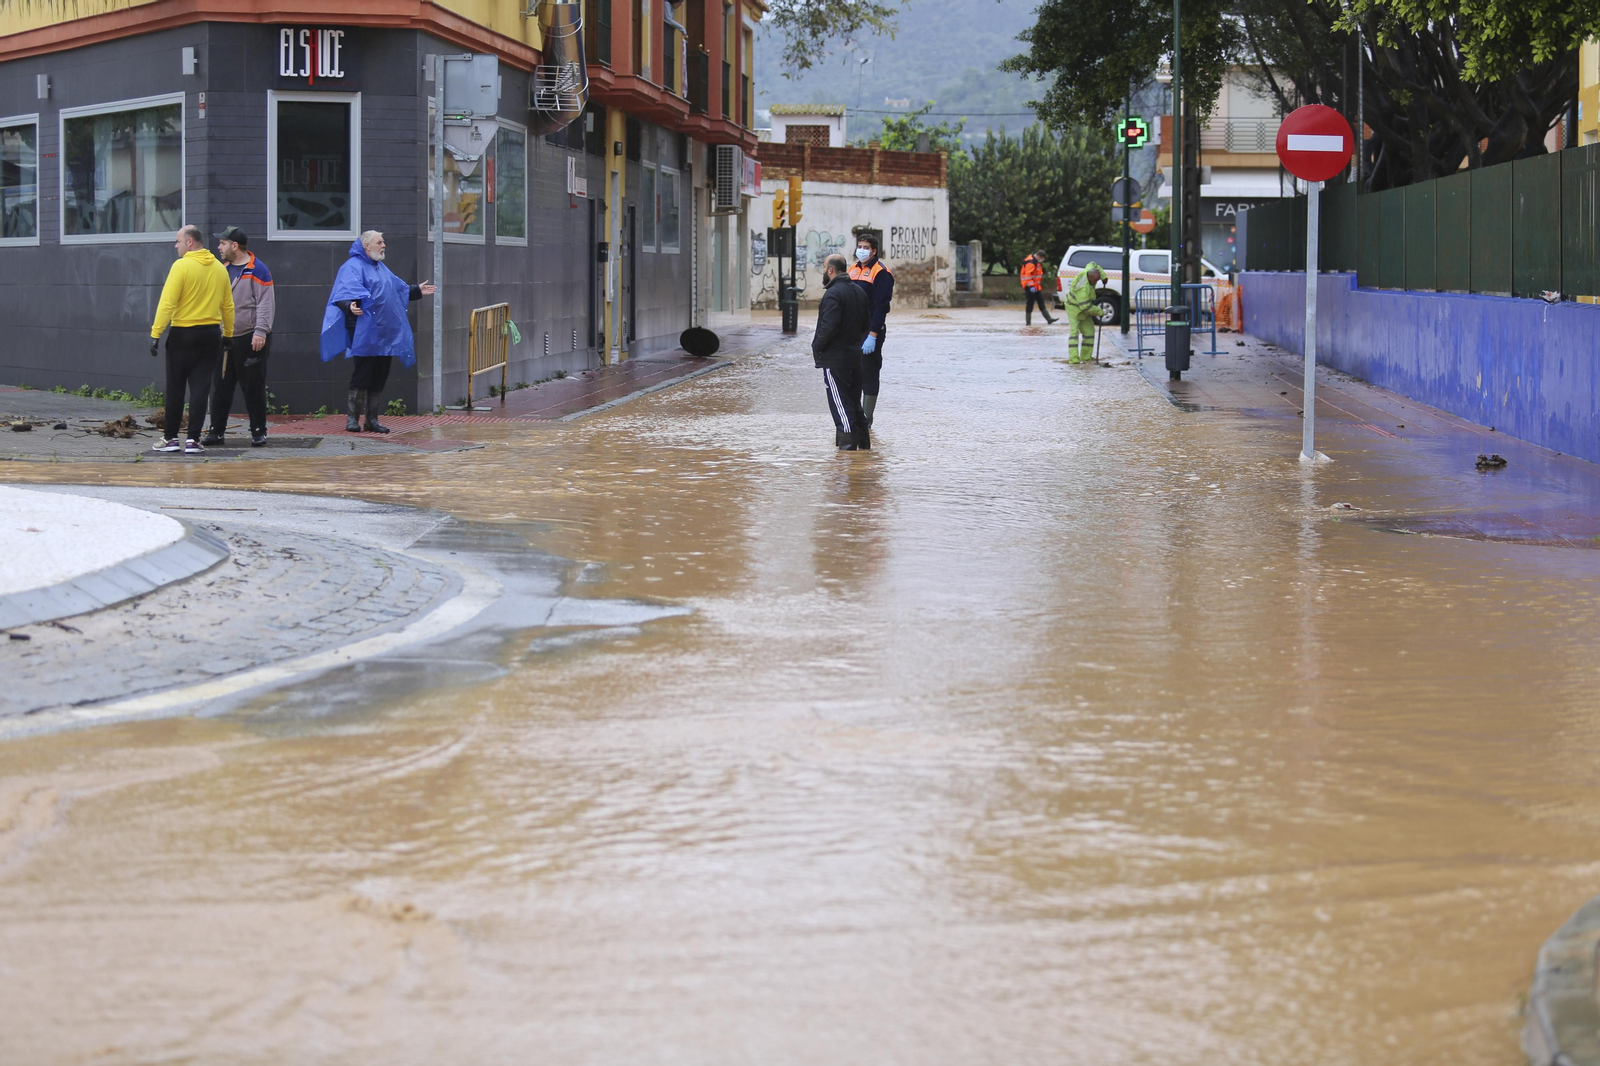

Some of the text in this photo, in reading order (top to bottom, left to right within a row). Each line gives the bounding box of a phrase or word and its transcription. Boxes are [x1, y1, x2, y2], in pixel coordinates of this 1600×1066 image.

[280, 28, 345, 85] EL SAUCE
[891, 227, 937, 246] PROXIMO
[891, 244, 926, 260] DERRIBO
